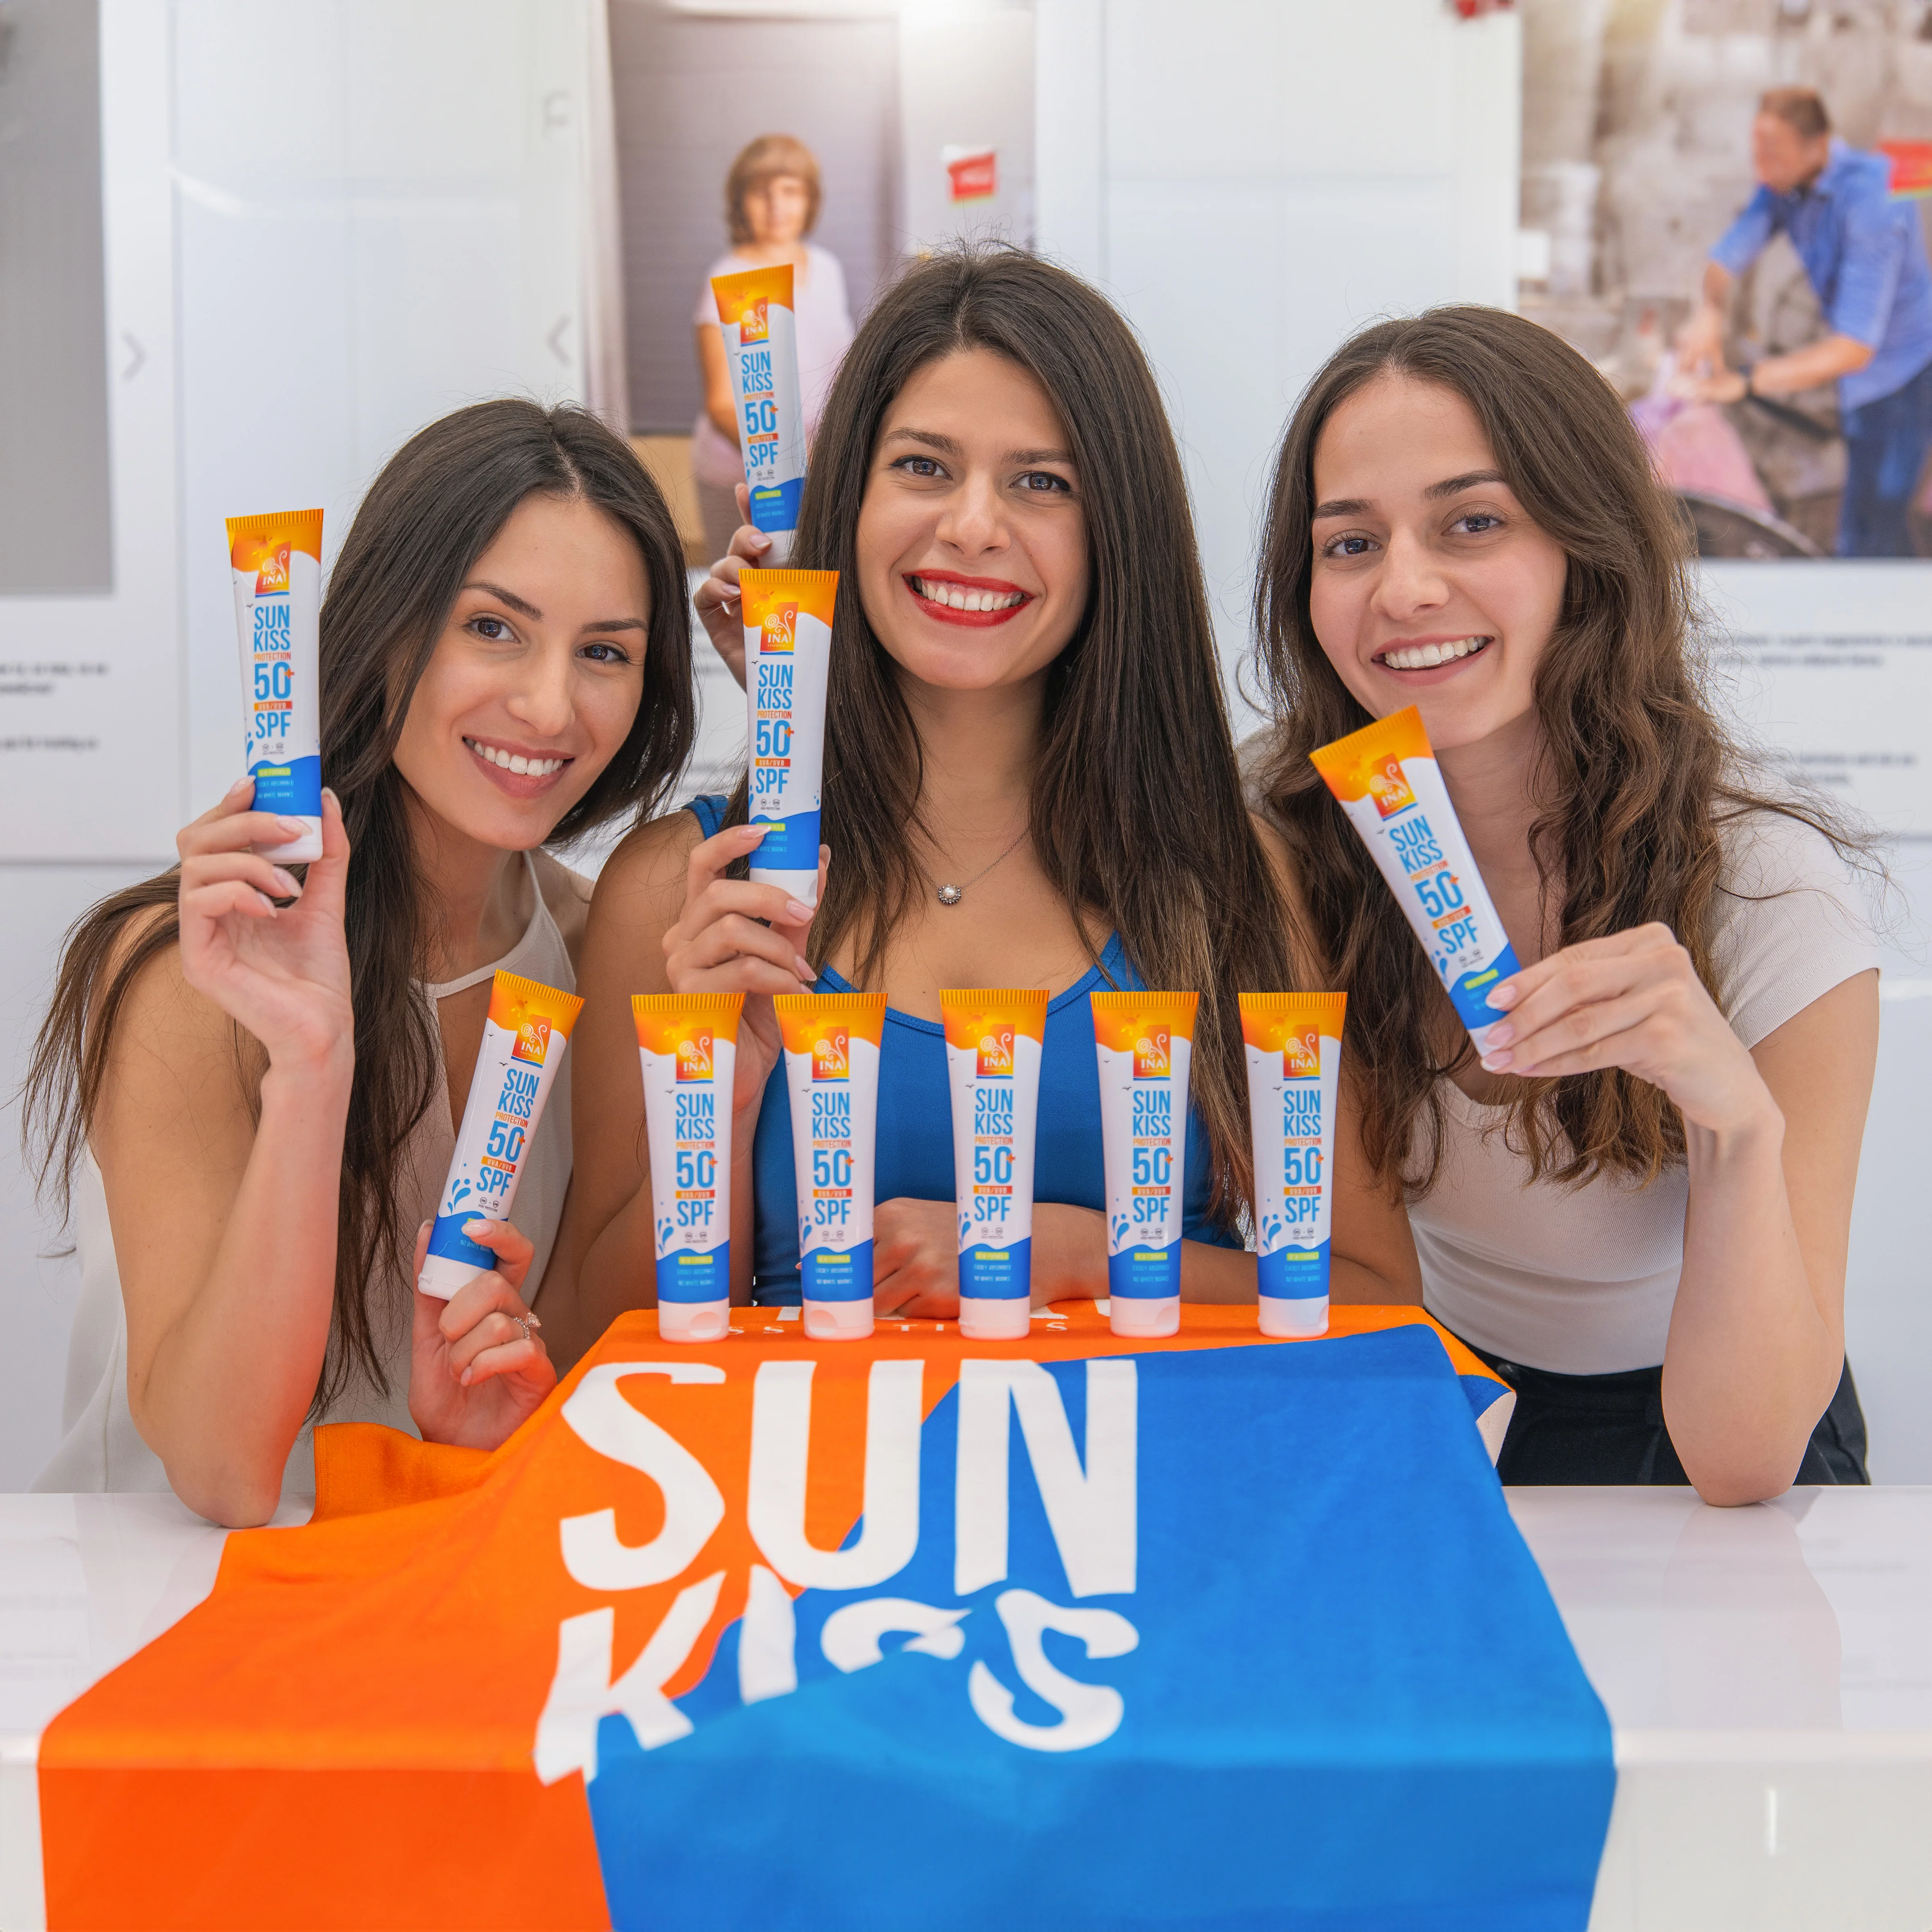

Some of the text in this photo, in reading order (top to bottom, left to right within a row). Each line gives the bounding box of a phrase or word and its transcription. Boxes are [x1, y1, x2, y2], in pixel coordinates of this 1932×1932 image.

[746, 325, 763, 335] INA
[741, 351, 771, 375] SUN
[742, 372, 773, 394] KISS
[744, 391, 775, 402] PROTECTION
[749, 442, 778, 467] SPF
[263, 574, 283, 585] INA
[254, 605, 290, 630] SUN
[254, 629, 290, 652] KISS
[768, 634, 789, 643] INA
[254, 652, 291, 662] PROTECTION
[758, 665, 793, 687] SUN
[758, 688, 793, 710] KISS
[256, 712, 292, 739] SPF
[757, 710, 792, 719] PROTECTION
[756, 768, 789, 794] SPF
[1381, 789, 1406, 807] INA
[1389, 815, 1433, 851] SUN
[1399, 838, 1443, 874] KISS
[1438, 916, 1478, 955] SPF
[521, 1041, 540, 1056] INA
[683, 1062, 707, 1072] INA
[820, 1061, 842, 1071] INA
[984, 1057, 1007, 1067] INA
[1141, 1058, 1164, 1069] INA
[1291, 1058, 1314, 1069] INA
[504, 1068, 540, 1099] SUN
[497, 1090, 533, 1119] KISS
[676, 1093, 714, 1117] SUN
[813, 1092, 849, 1116] SUN
[975, 1088, 1013, 1113] SUN
[1133, 1090, 1170, 1114] SUN
[1284, 1090, 1321, 1114] SUN
[495, 1111, 528, 1128] PROTECTION
[676, 1119, 714, 1140] KISS
[813, 1117, 850, 1139] KISS
[975, 1114, 1013, 1134] KISS
[1133, 1115, 1171, 1137] KISS
[1284, 1114, 1321, 1137] KISS
[975, 1136, 1013, 1145] PROTECTION
[1133, 1138, 1171, 1146] PROTECTION
[1284, 1137, 1322, 1146] PROTECTION
[476, 1167, 513, 1197] SPF
[677, 1200, 714, 1227] SPF
[815, 1199, 851, 1225] SPF
[974, 1196, 1011, 1222] SPF
[1133, 1197, 1170, 1223] SPF
[1285, 1197, 1321, 1223] SPF
[467, 1241, 479, 1250] WHITE
[560, 1359, 1138, 1598] SUN
